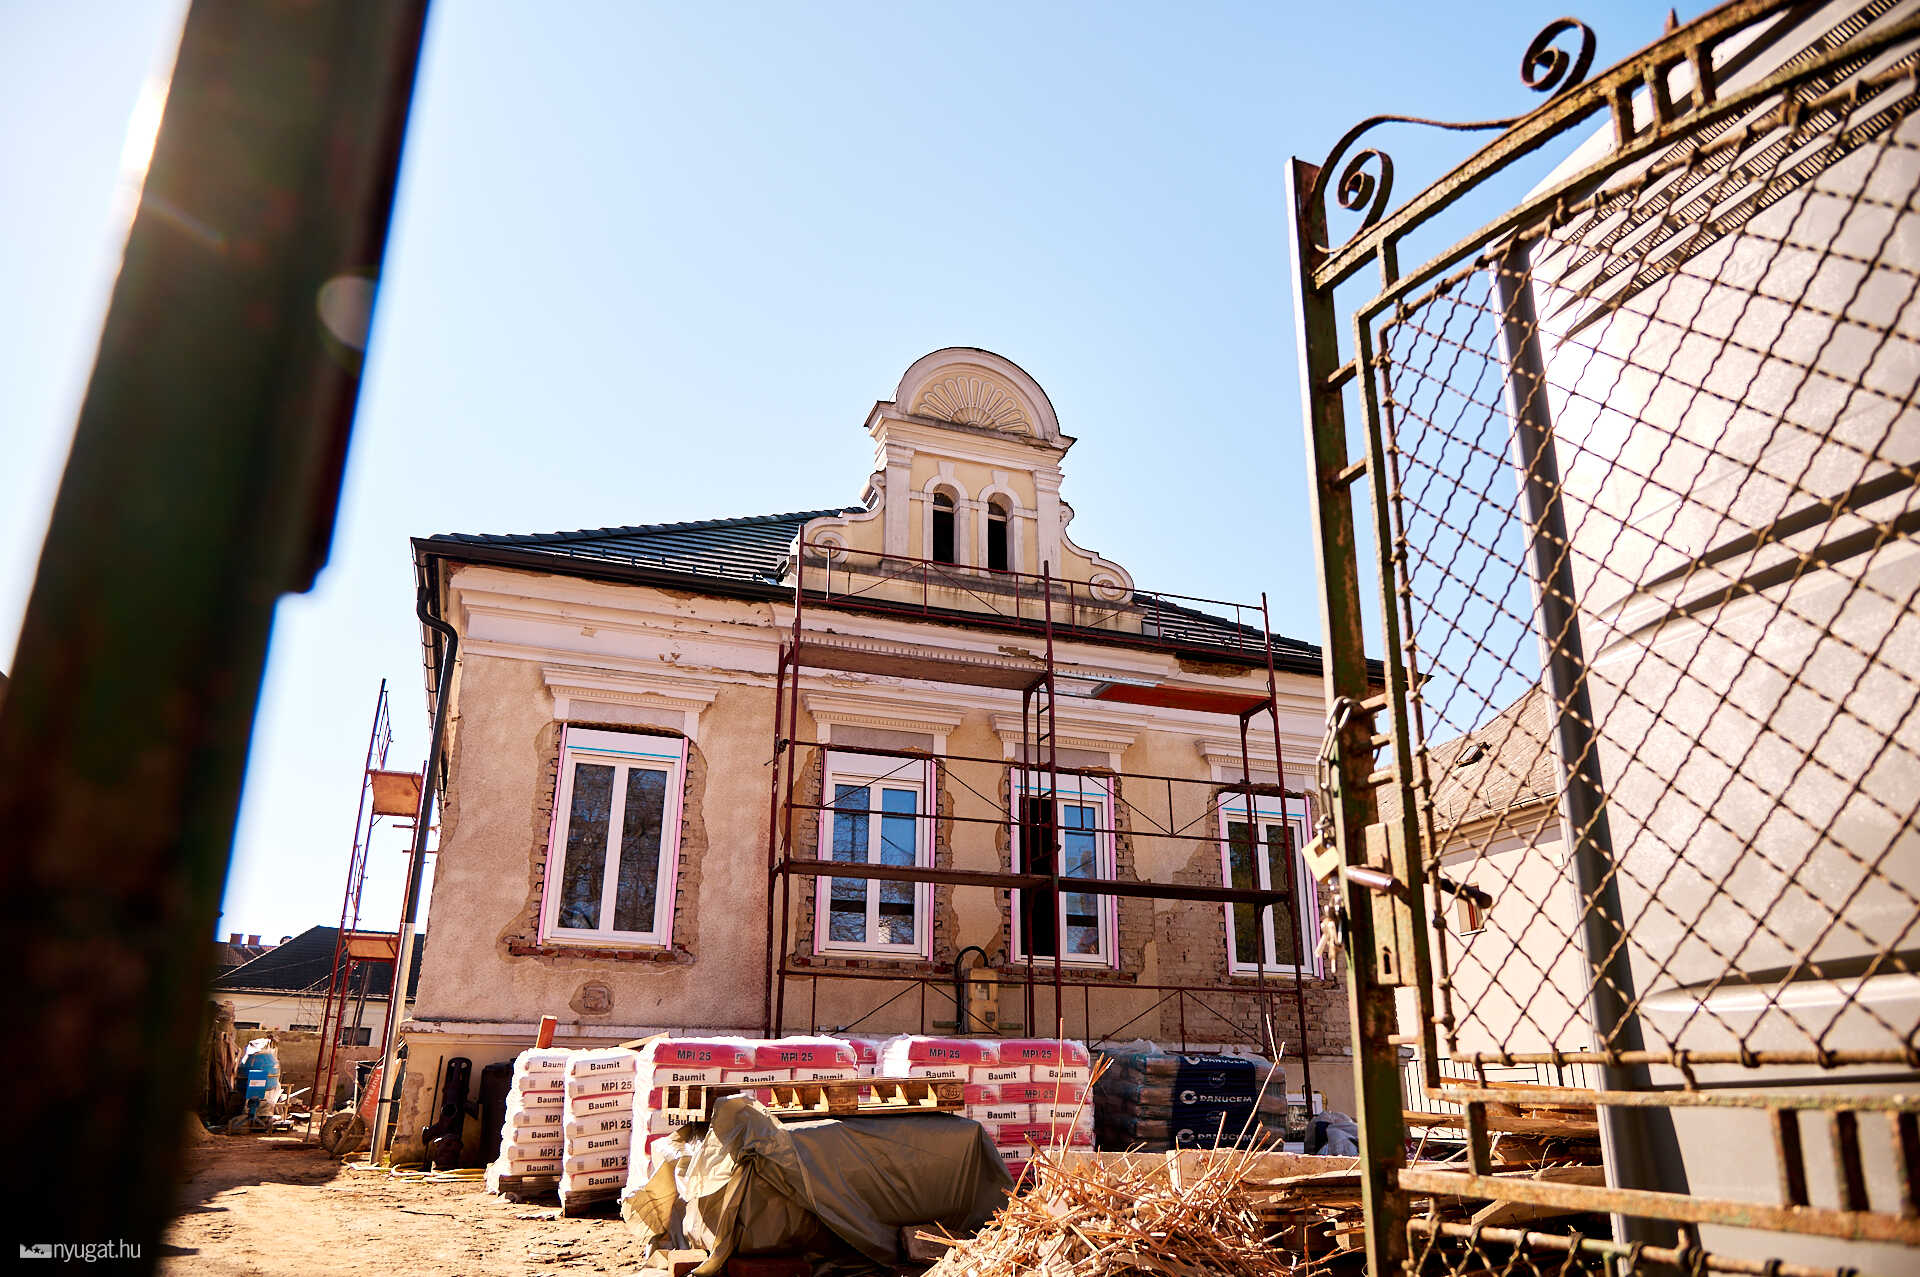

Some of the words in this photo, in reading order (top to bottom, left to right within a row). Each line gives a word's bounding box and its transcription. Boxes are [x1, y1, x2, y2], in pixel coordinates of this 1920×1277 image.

[677, 1050, 696, 1060] MPI
[699, 1051, 712, 1061] 25
[781, 1052, 798, 1062] MPI
[801, 1052, 813, 1061] 25
[929, 1048, 946, 1058] MPI
[949, 1049, 960, 1059] 25
[1022, 1048, 1039, 1058] MPI
[1041, 1049, 1052, 1059] 25
[590, 1061, 620, 1070] Baumit
[672, 1073, 706, 1082] Baumit
[926, 1070, 956, 1079] Baumit
[988, 1071, 1017, 1080] Baumit
[1049, 1070, 1077, 1079] Baumit
[601, 1082, 618, 1091] MPI
[621, 1081, 632, 1090] 25
[1025, 1090, 1040, 1098] MPI
[1044, 1090, 1054, 1098] 25
[537, 1096, 565, 1104] Baumit
[1200, 1095, 1252, 1103] DANUCEM
[588, 1099, 619, 1110] Baumit
[545, 1114, 561, 1123] MPI
[987, 1110, 1017, 1119] Baumit
[600, 1121, 618, 1131] MPI
[620, 1119, 632, 1129] 25
[531, 1130, 559, 1139] Baumit
[588, 1138, 619, 1149] Baumit
[540, 1148, 556, 1157] MPI
[1000, 1150, 1019, 1159] umit
[601, 1158, 619, 1168] MPI
[526, 1164, 555, 1172] Baumit
[588, 1175, 619, 1186] Baumit
